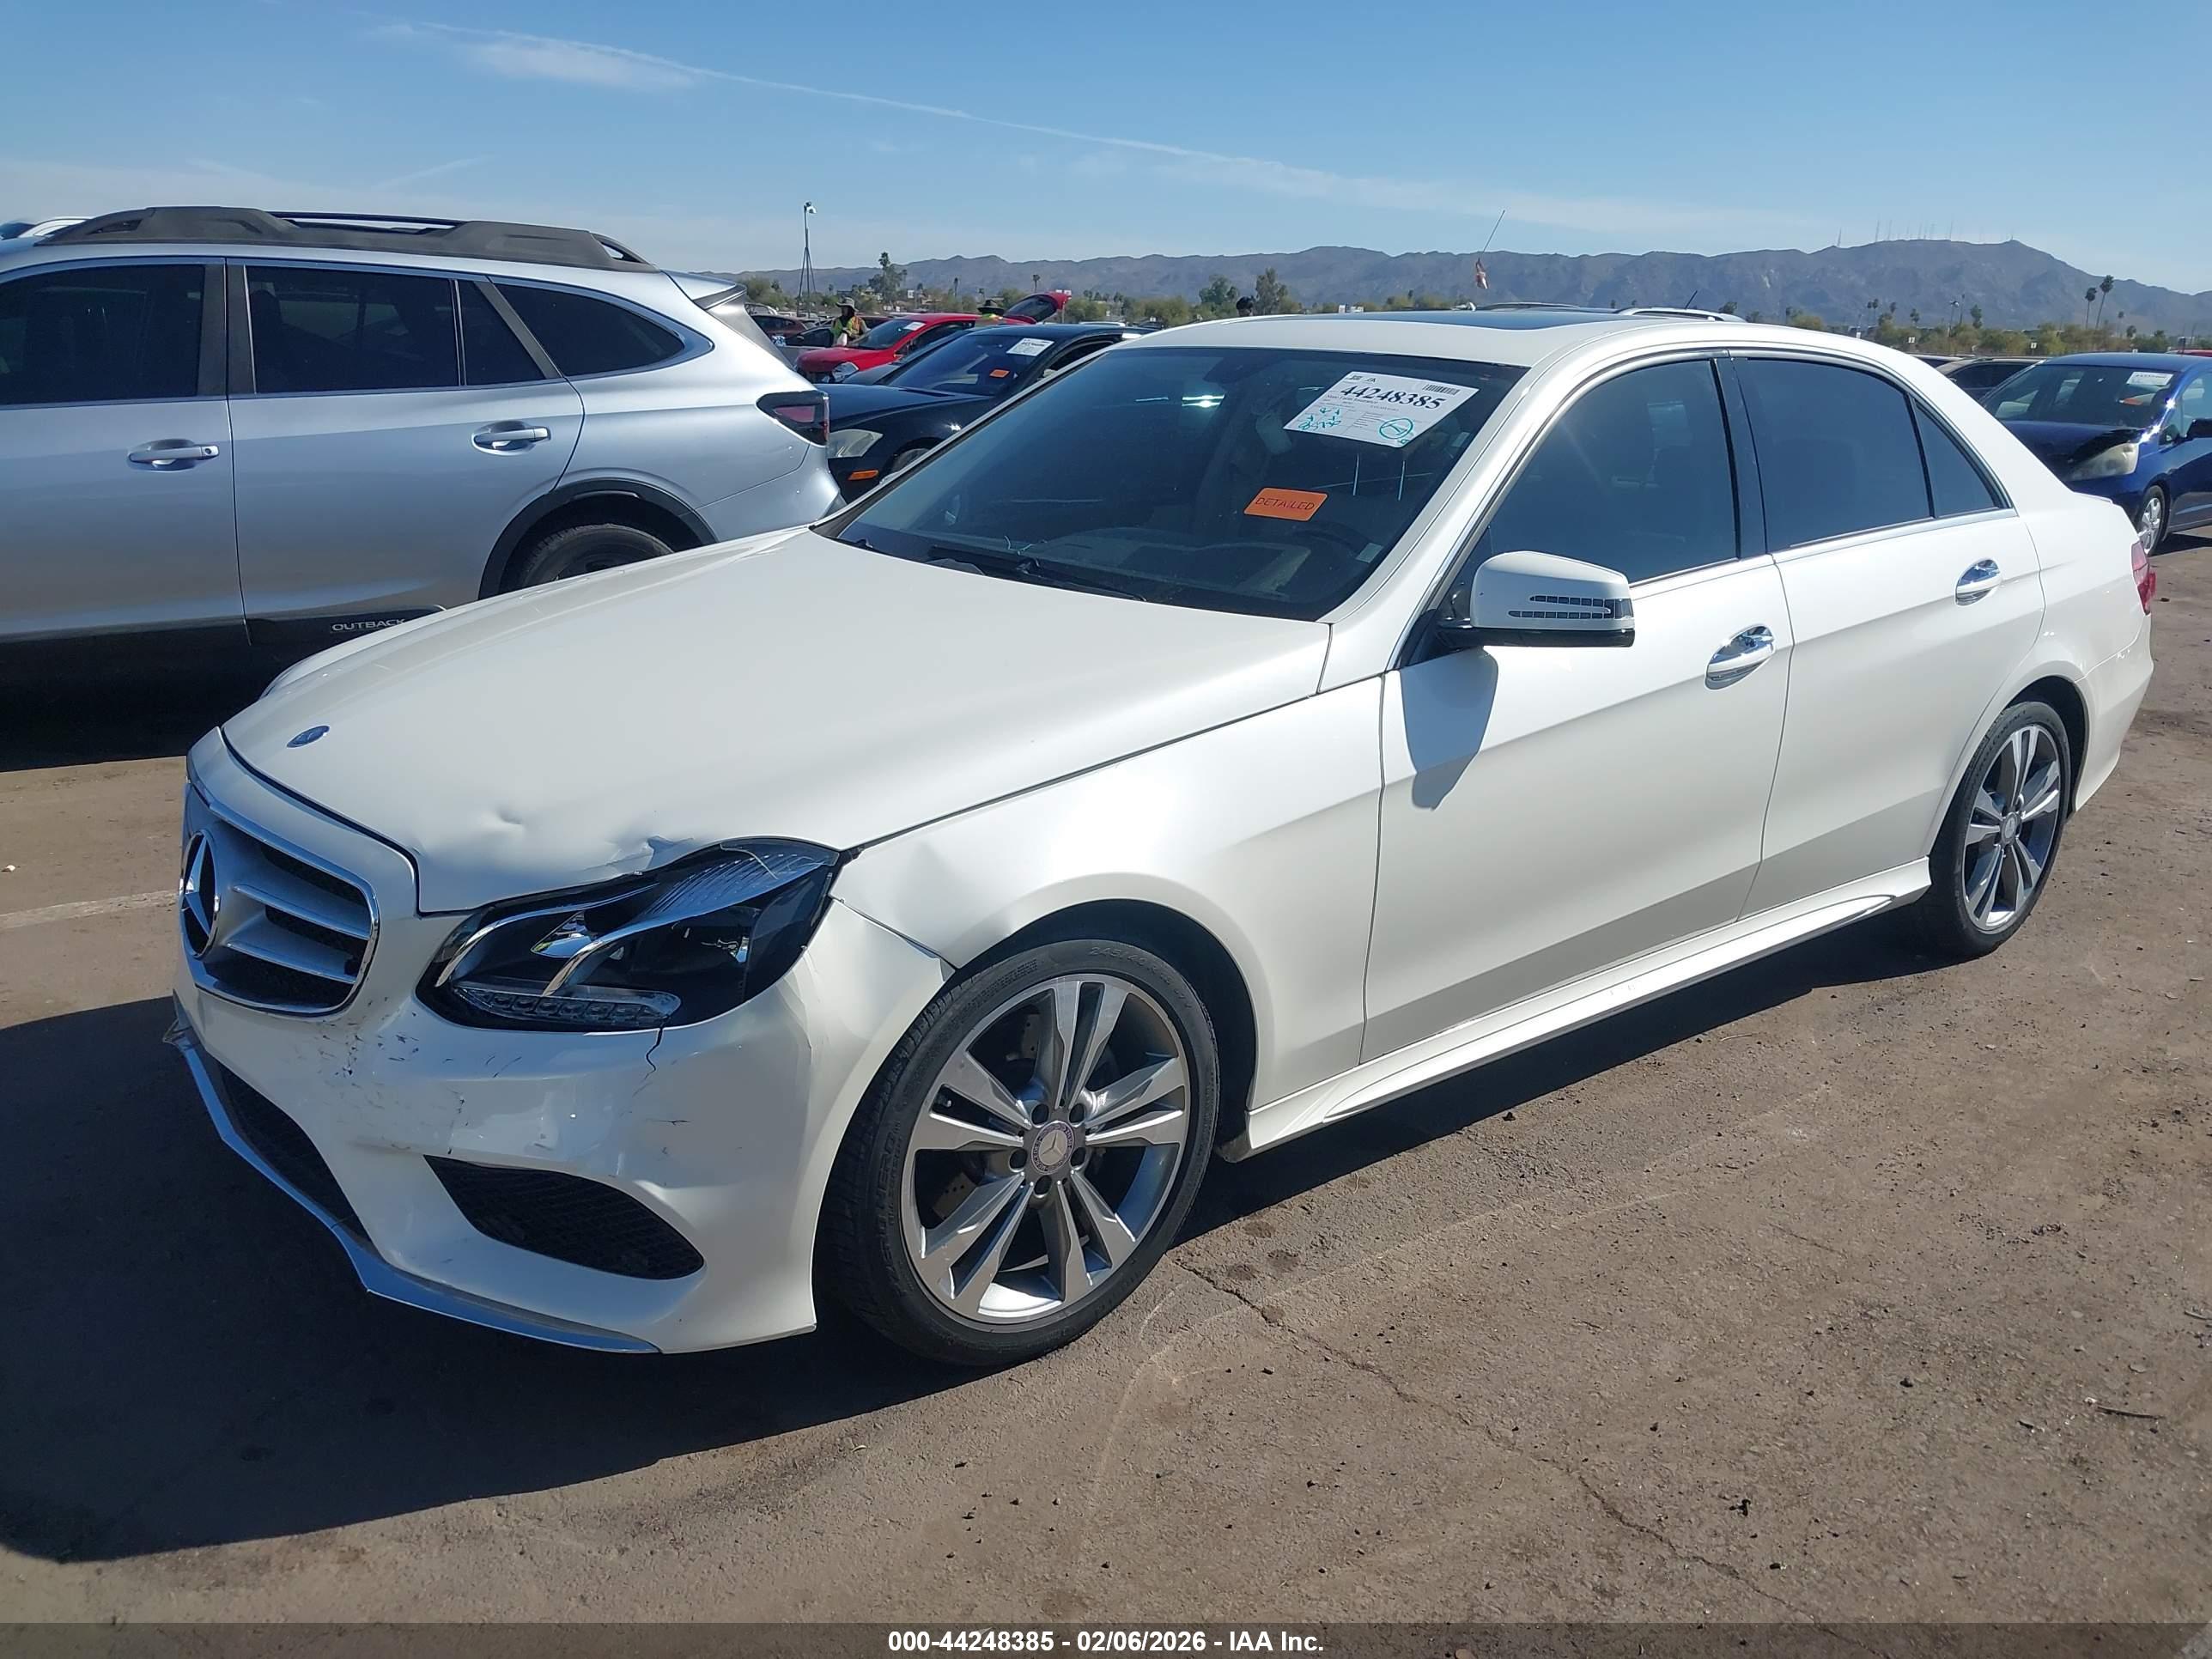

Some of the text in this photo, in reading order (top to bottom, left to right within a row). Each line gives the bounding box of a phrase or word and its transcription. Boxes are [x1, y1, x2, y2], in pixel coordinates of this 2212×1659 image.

[1340, 386, 1446, 410] 44248385
[1255, 497, 1316, 511] DETAILED
[331, 618, 406, 631] OUTBACK
